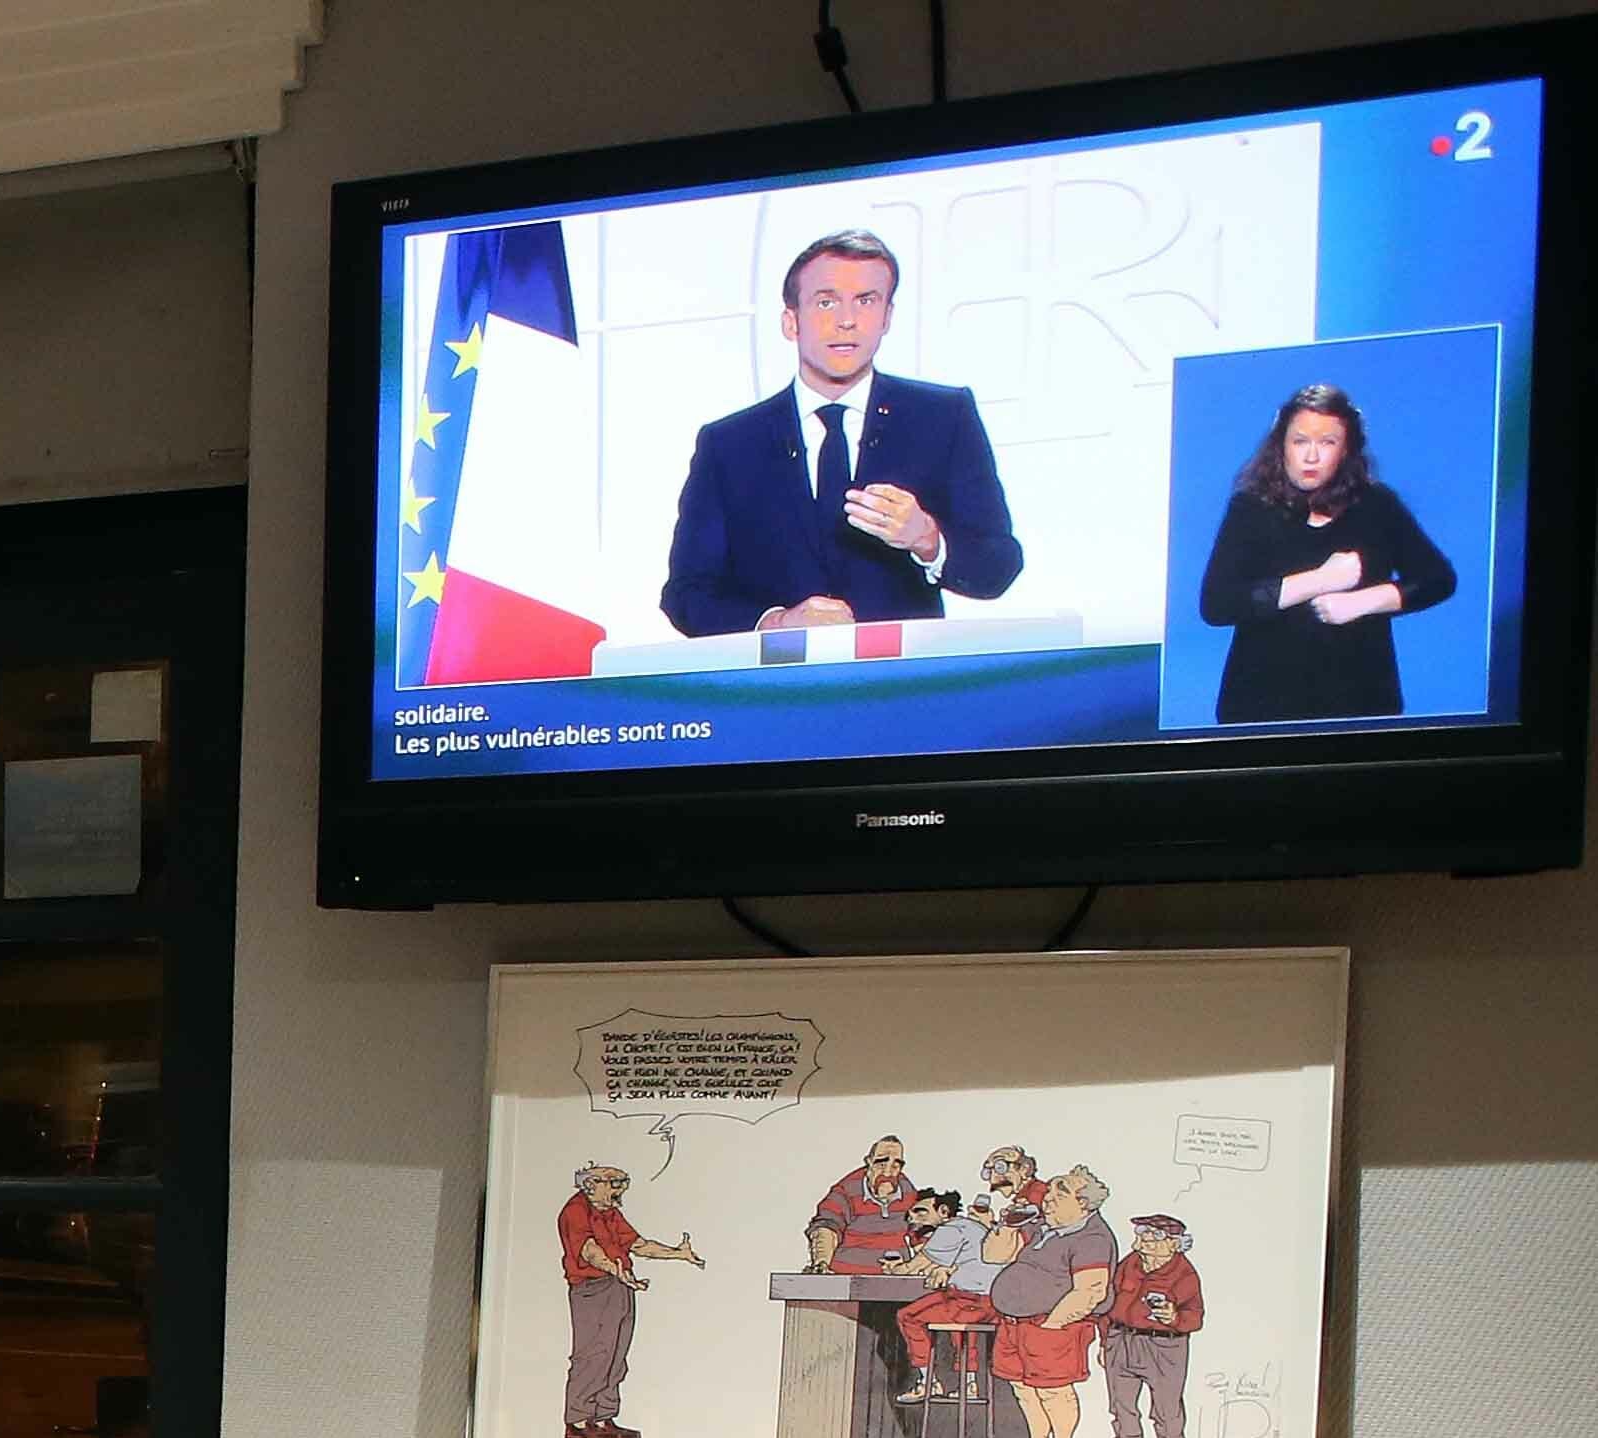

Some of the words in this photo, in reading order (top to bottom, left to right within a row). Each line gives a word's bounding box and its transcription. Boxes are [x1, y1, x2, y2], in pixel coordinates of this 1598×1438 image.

[1454, 111, 1492, 161] 2
[395, 704, 489, 725] solidaire.
[395, 734, 430, 754] Les
[436, 732, 480, 756] plus
[487, 725, 611, 748] vulnérables
[618, 722, 665, 742] sont
[671, 721, 711, 739] nos
[855, 811, 945, 827] Panasonic
[605, 1044, 620, 1054] LA
[601, 1055, 629, 1065] VOUS
[605, 1067, 631, 1077] QUE
[663, 1067, 680, 1077] NE
[674, 1079, 701, 1088] VOUS
[756, 1079, 784, 1088] QUE
[607, 1091, 623, 1103] ÇA
[658, 1090, 686, 1099] PLUS
[690, 1089, 729, 1099] COMME
